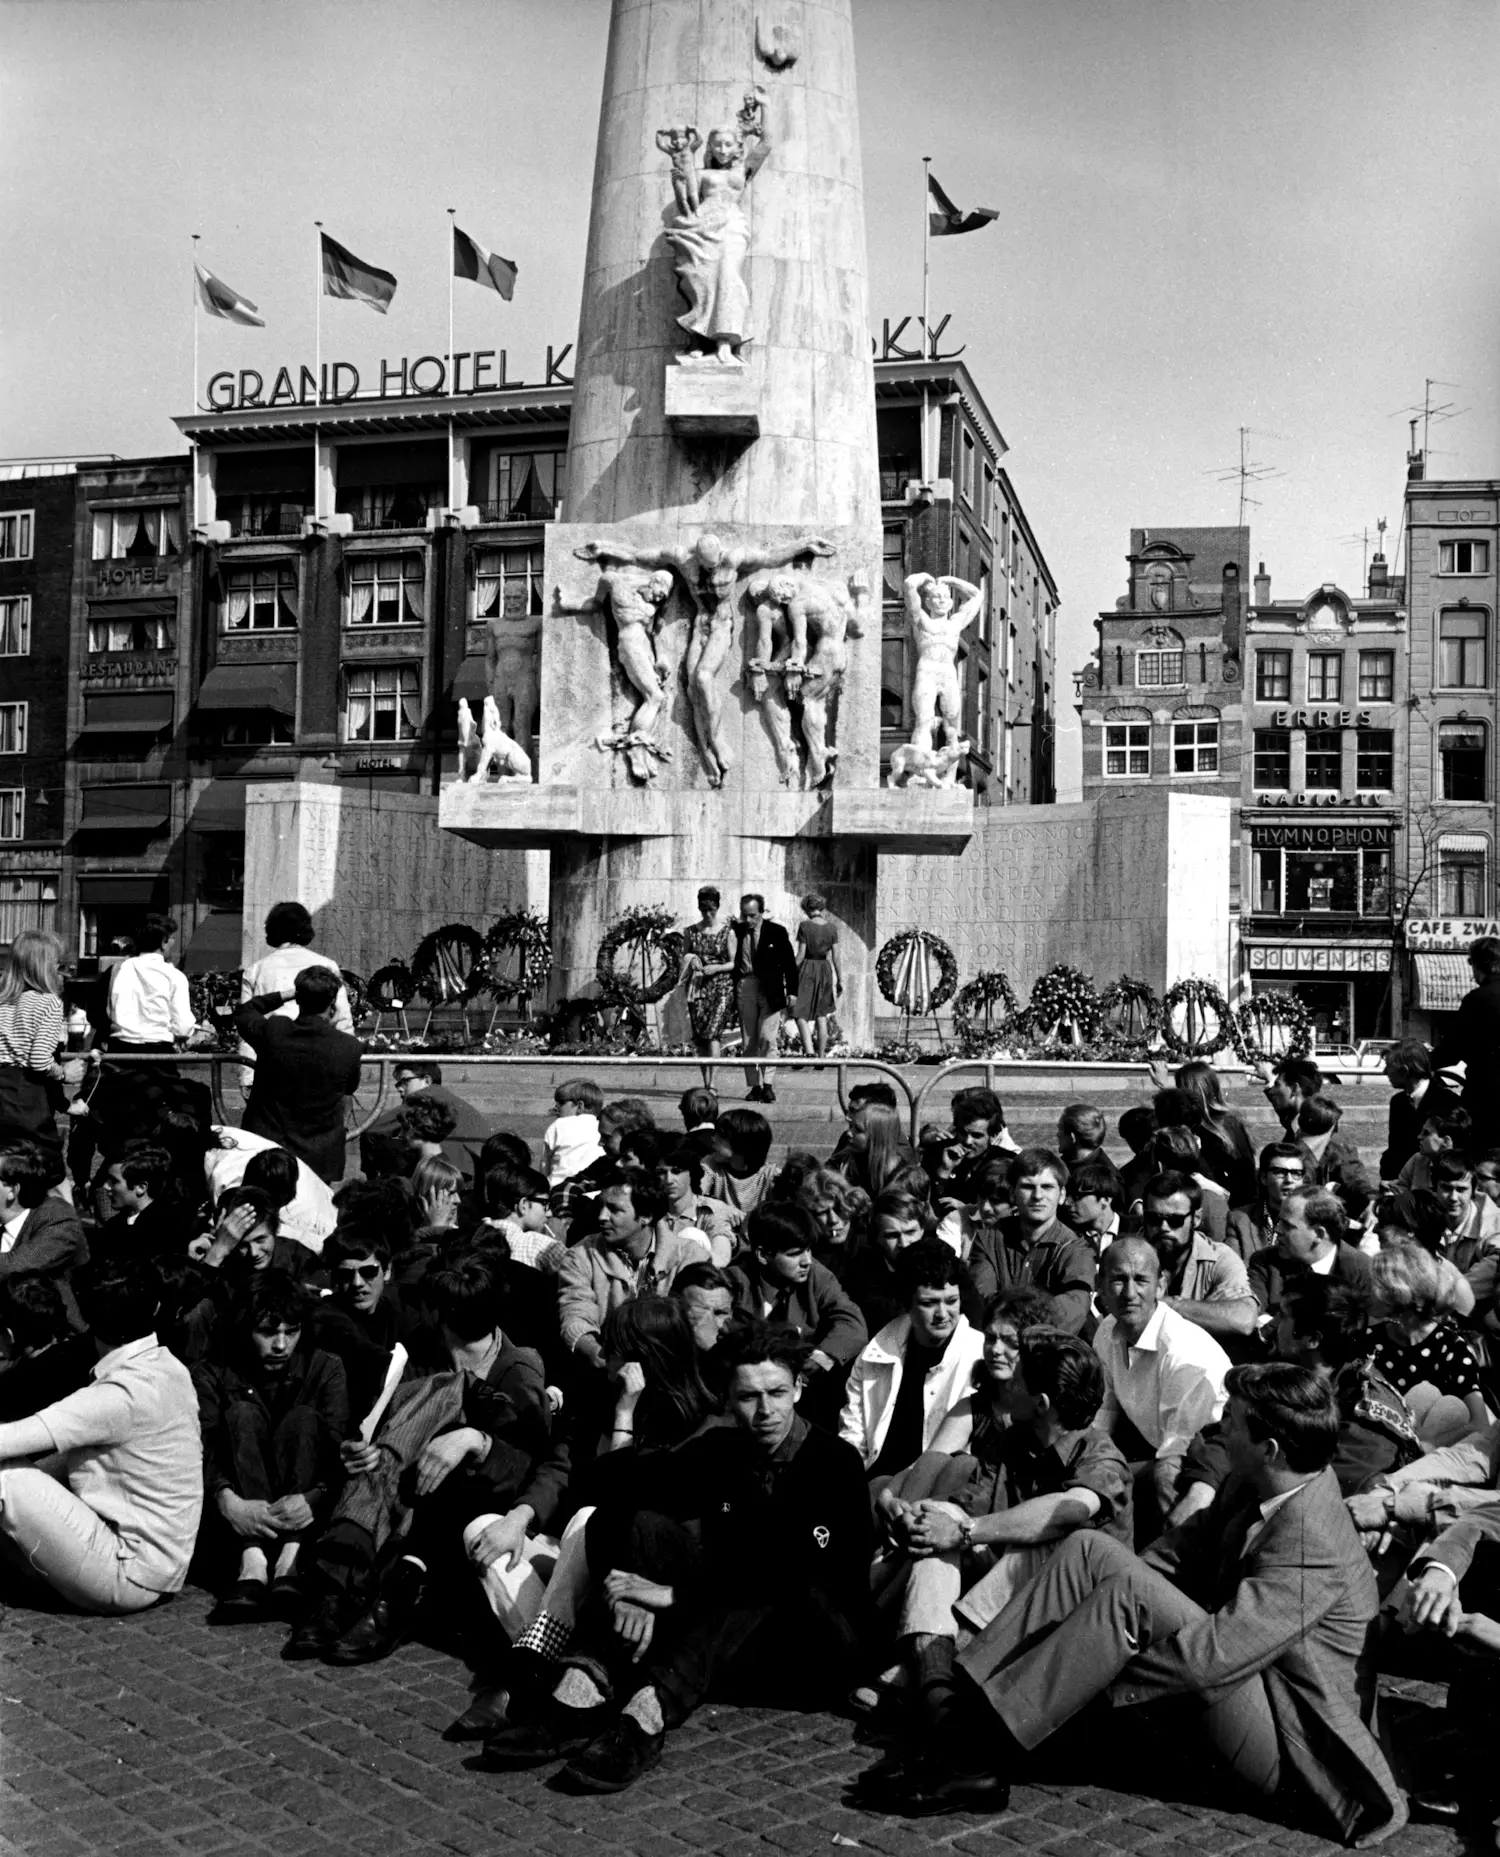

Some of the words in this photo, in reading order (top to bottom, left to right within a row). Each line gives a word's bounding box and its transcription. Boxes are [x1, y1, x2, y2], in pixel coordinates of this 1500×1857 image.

[207, 362, 360, 410] GRAND
[380, 349, 524, 396] HOTEL
[98, 566, 166, 582] HOTEL
[80, 660, 177, 678] RESTAURANT
[1275, 709, 1373, 726] ERRES
[358, 758, 395, 769] HOTEL
[1255, 828, 1388, 844] HYMNOPHON
[1408, 921, 1452, 936] CAFE
[1252, 950, 1392, 969] SOUVENIRS
